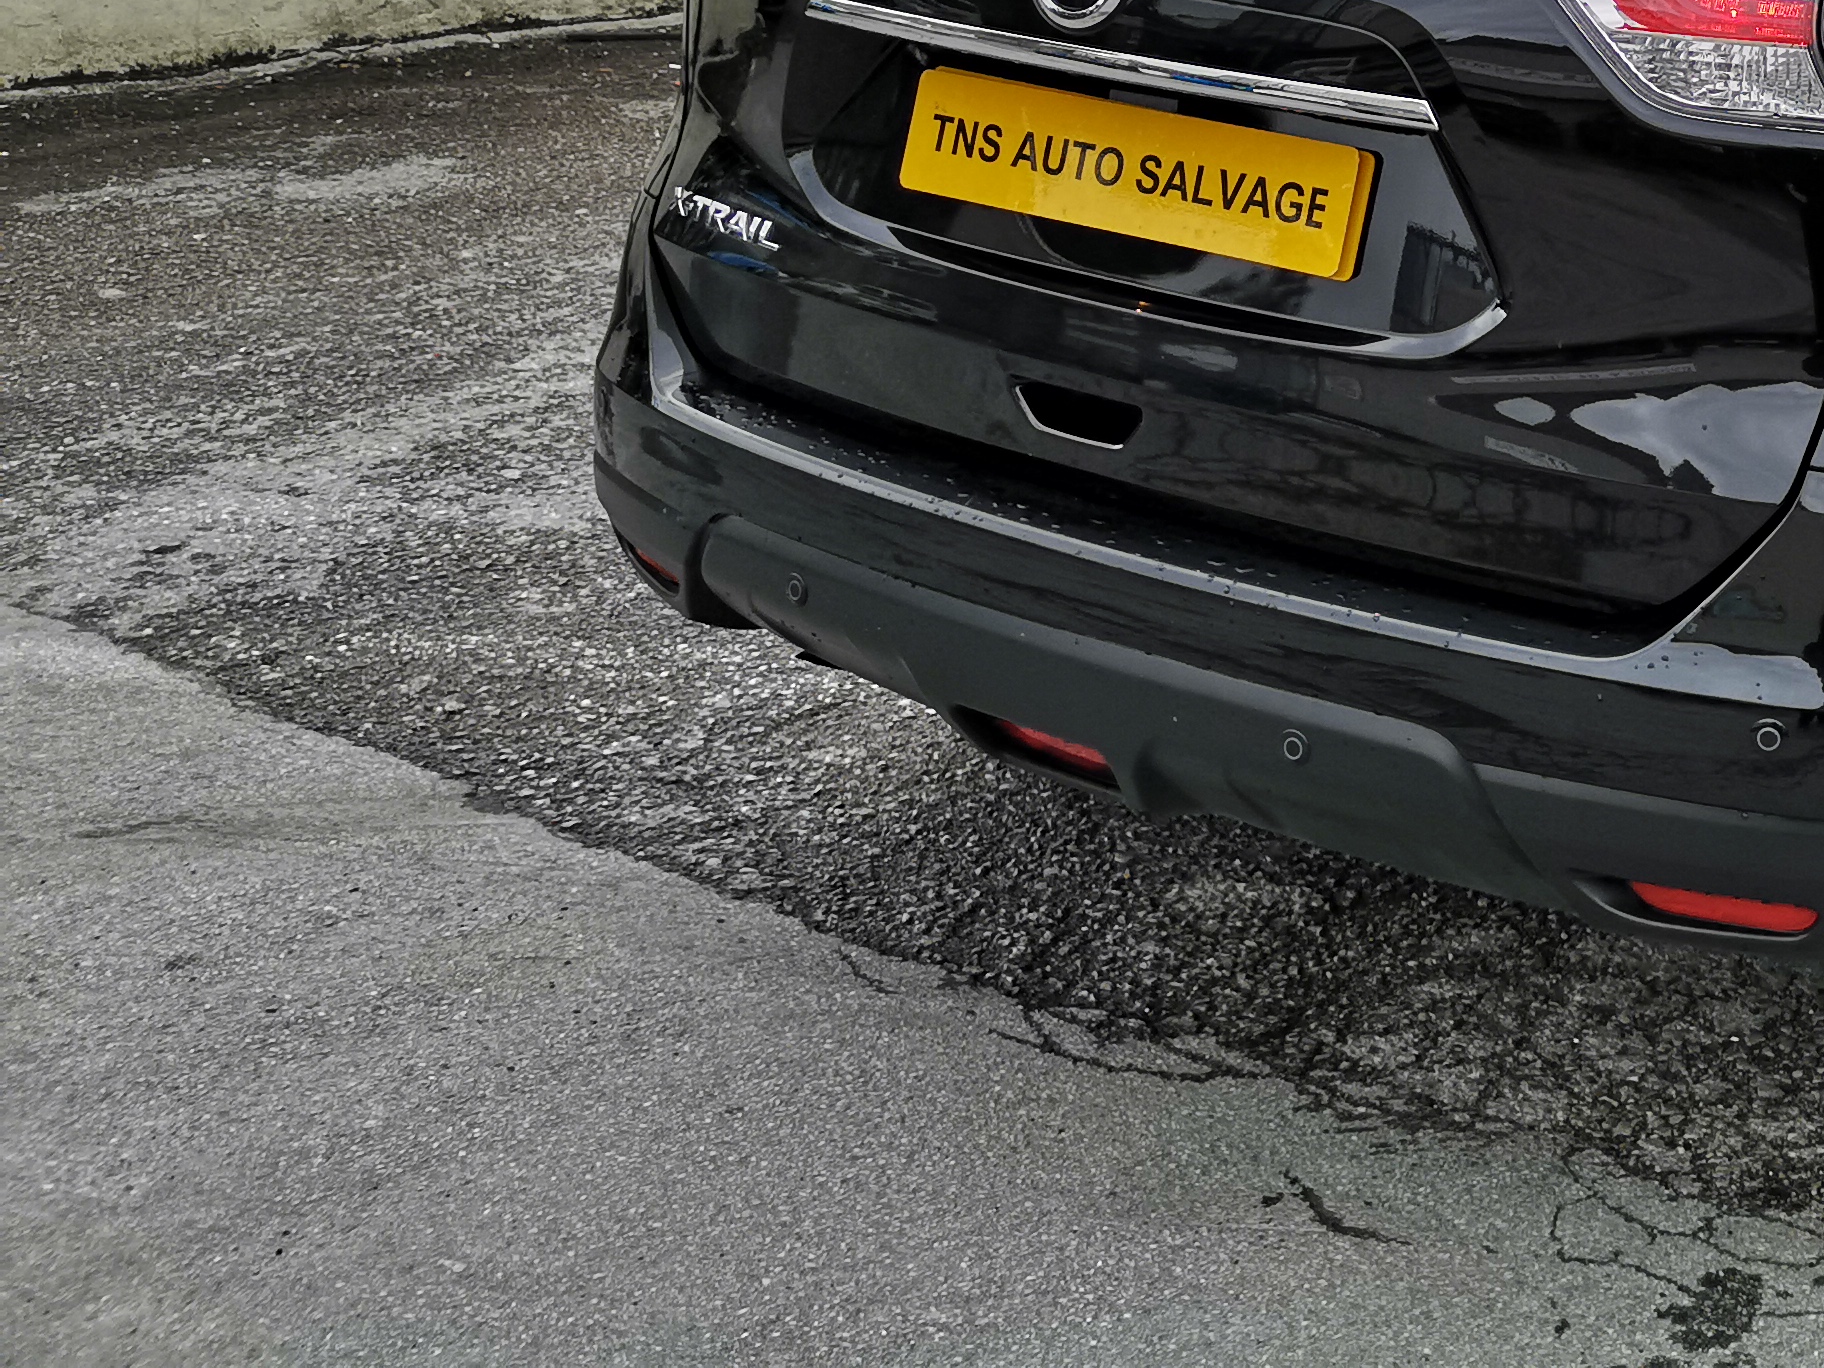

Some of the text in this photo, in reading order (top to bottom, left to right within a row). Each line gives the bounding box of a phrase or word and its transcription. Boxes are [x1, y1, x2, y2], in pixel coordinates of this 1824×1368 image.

[933, 113, 1330, 230] TNS AUTO SALVAGE
[670, 185, 782, 252] X-TRAIL
